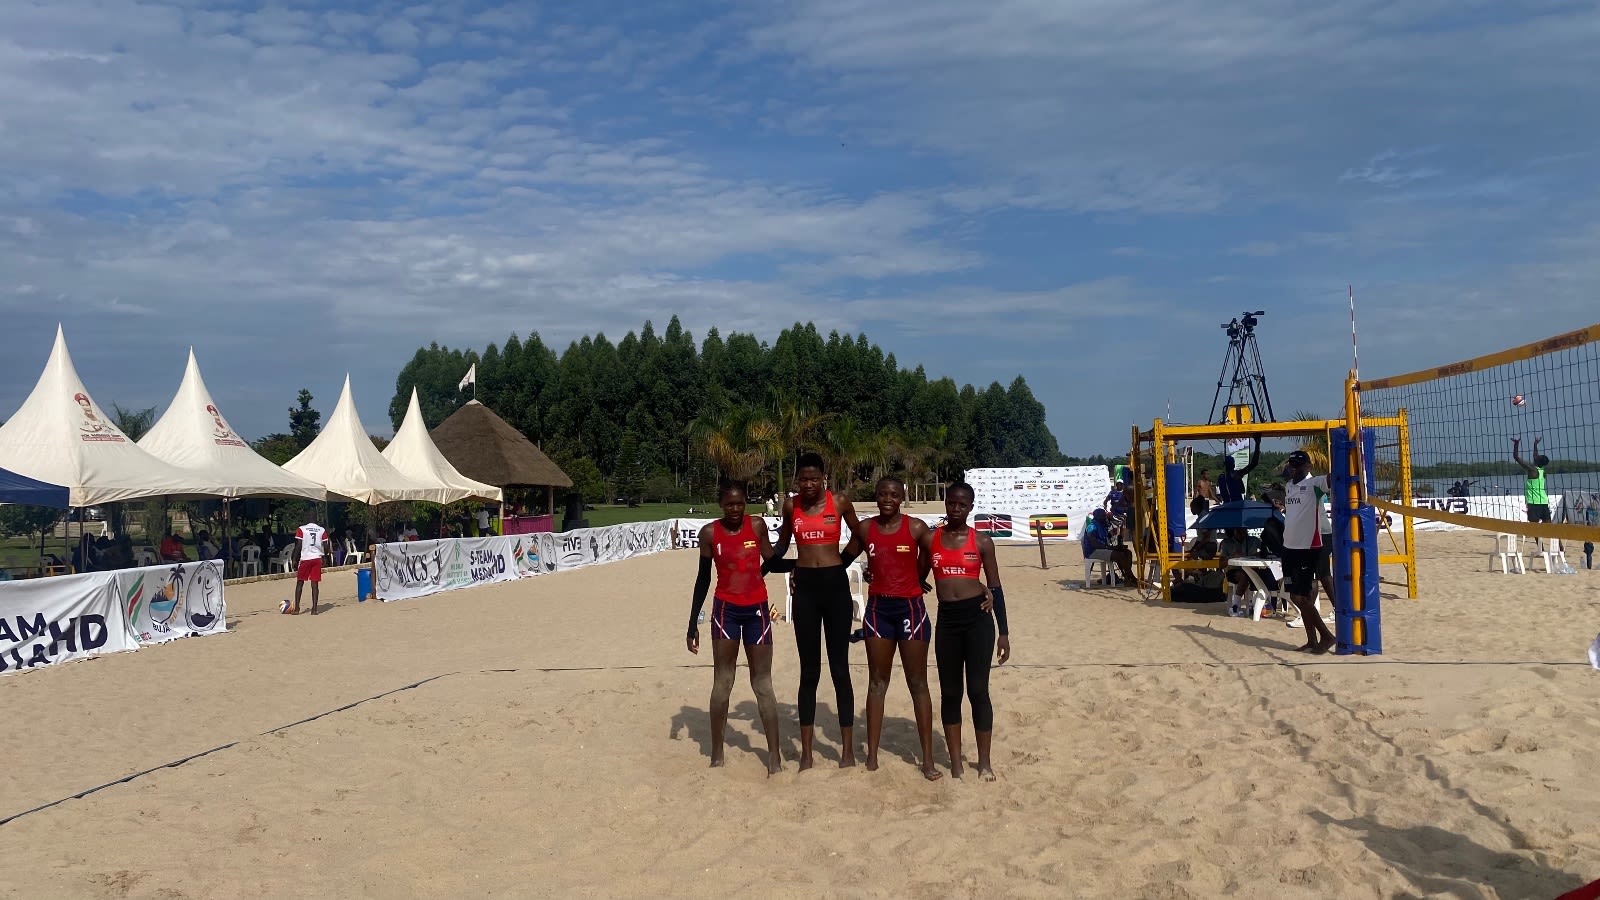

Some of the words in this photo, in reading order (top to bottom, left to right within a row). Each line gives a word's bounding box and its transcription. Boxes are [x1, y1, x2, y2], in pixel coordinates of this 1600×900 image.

[1286, 497, 1302, 505] ENYA
[802, 531, 824, 539] KEN
[717, 543, 722, 556] 1
[869, 543, 875, 557] 2
[933, 559, 939, 568] 2
[942, 567, 966, 575] KEN
[903, 619, 912, 632] 2
[49, 614, 108, 656] HD
